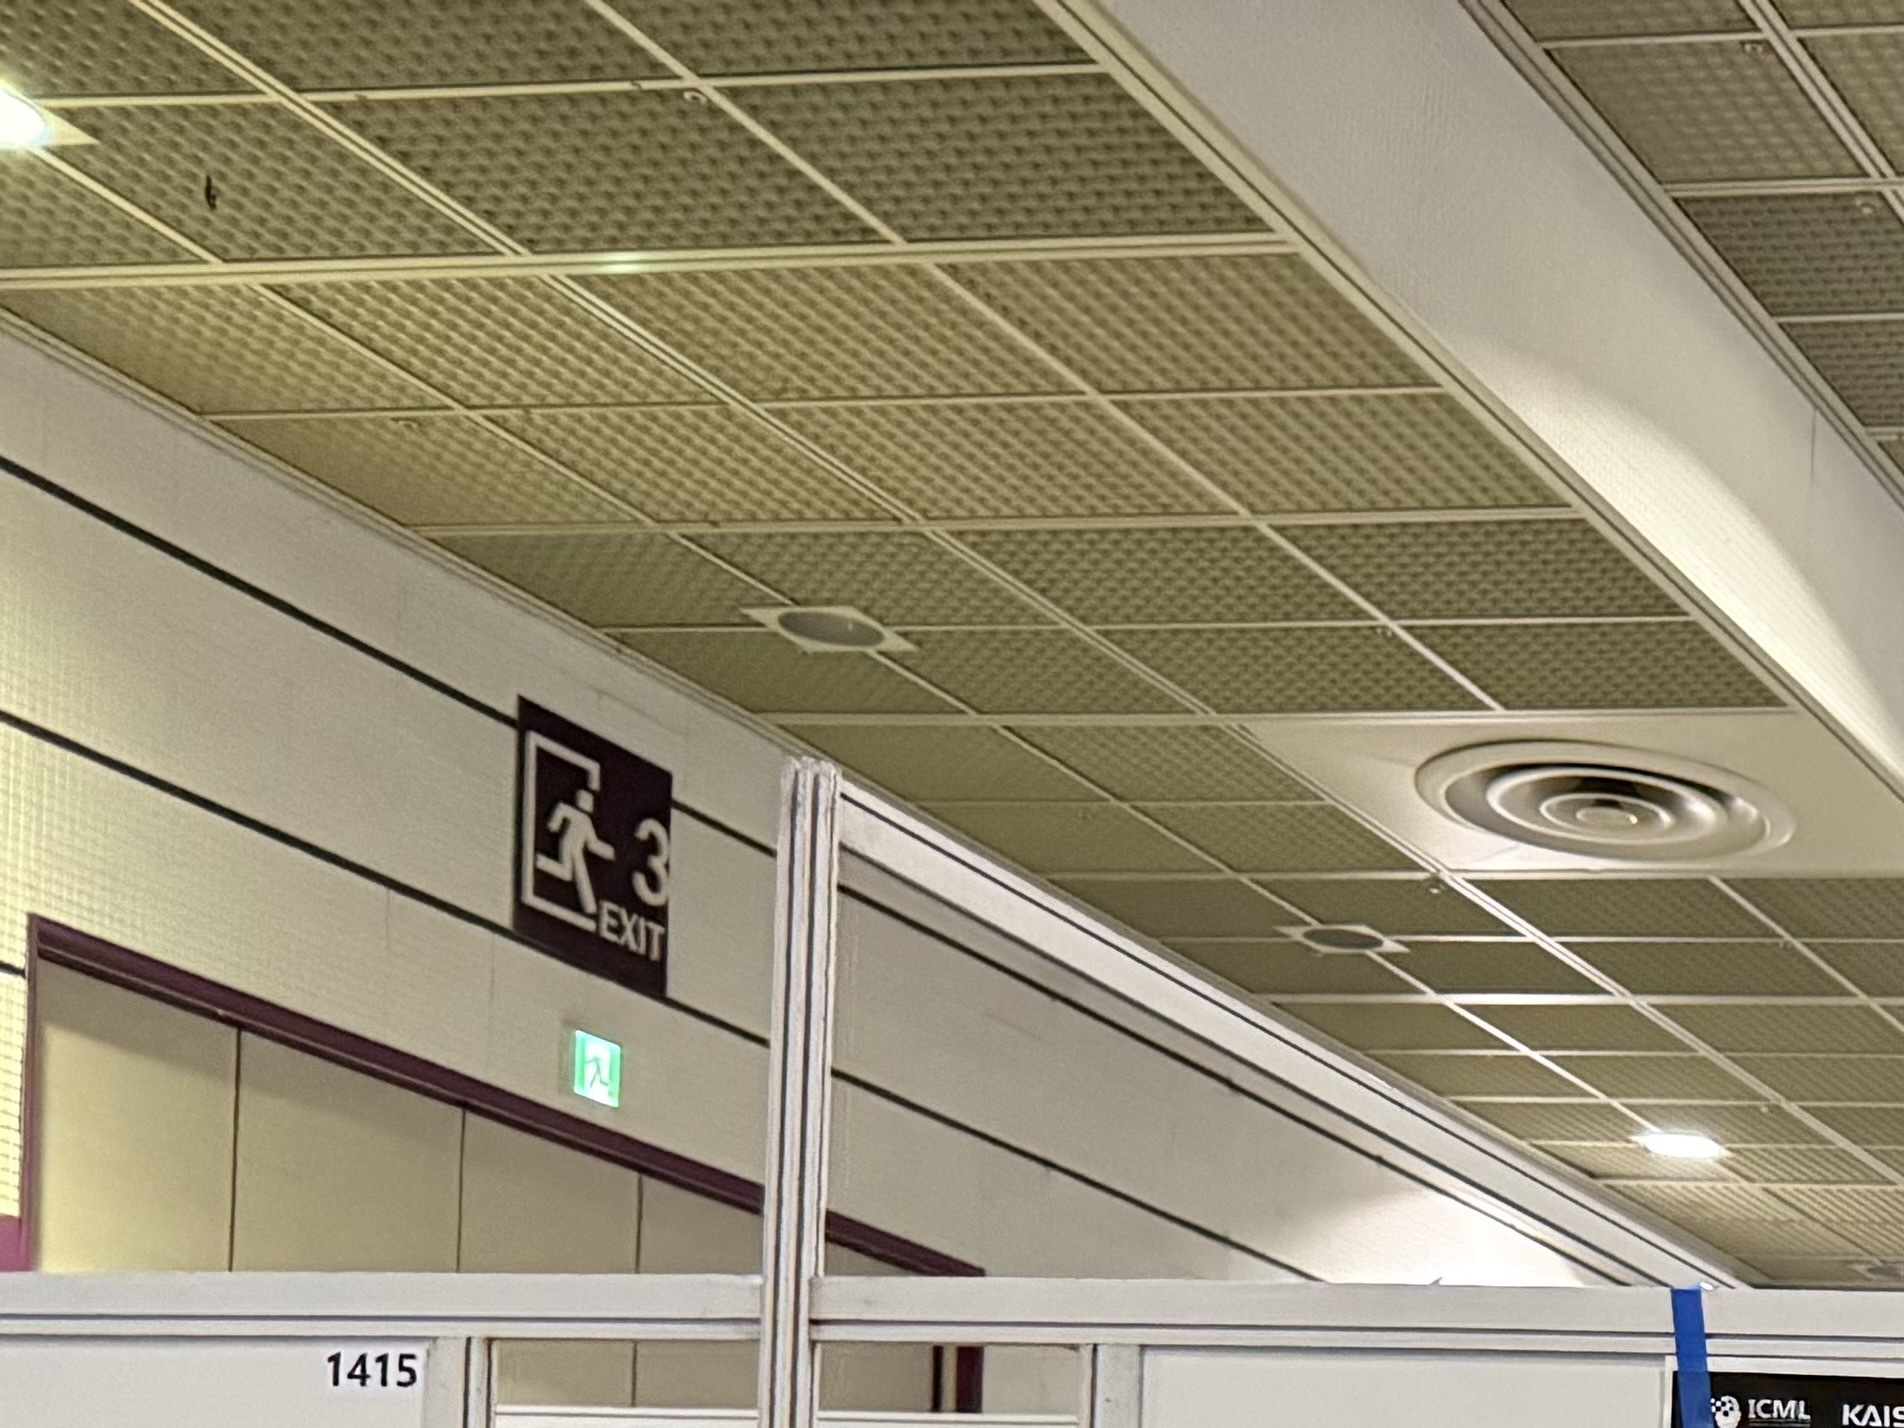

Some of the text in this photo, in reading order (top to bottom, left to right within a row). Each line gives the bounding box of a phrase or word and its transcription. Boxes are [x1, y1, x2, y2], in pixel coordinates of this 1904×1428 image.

[632, 818, 670, 907] 3
[601, 900, 665, 962] EXIT
[326, 1353, 418, 1388] 1415
[1748, 1399, 1811, 1420] ICML
